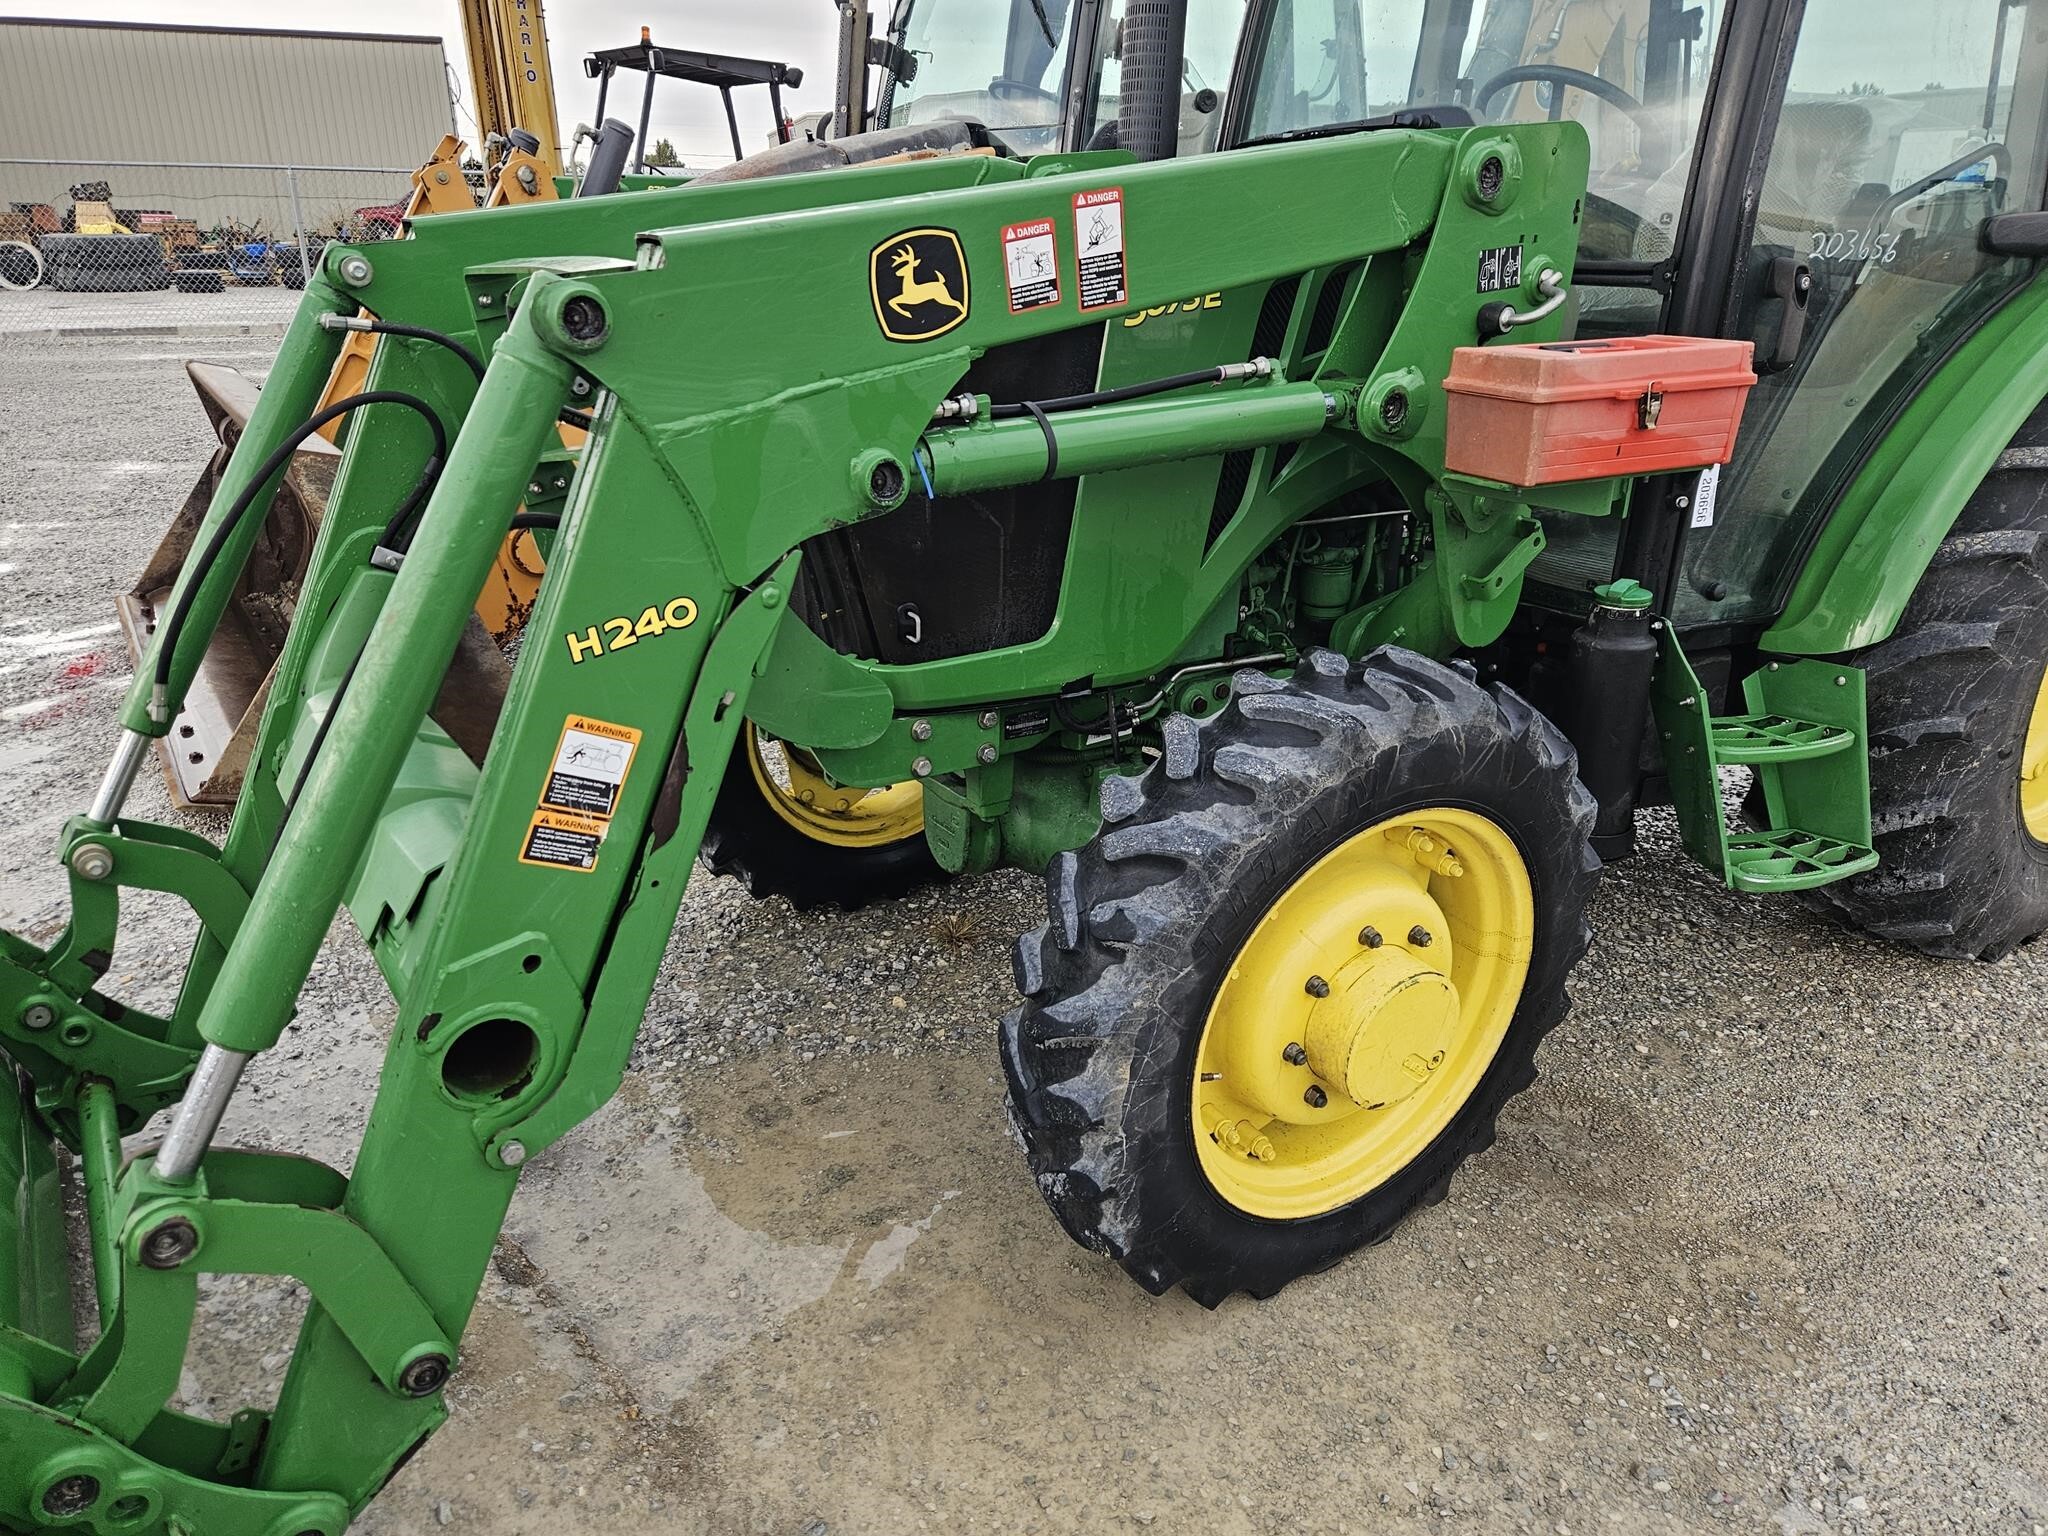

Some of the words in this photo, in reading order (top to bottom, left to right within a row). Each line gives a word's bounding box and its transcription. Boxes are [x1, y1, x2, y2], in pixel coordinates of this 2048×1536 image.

[1087, 191, 1119, 204] DANGER
[1017, 223, 1050, 238] DANGER
[1808, 228, 1900, 264] 203656
[1696, 477, 1712, 523] 203656
[587, 722, 632, 739] WARNING
[555, 817, 600, 833] WARNING
